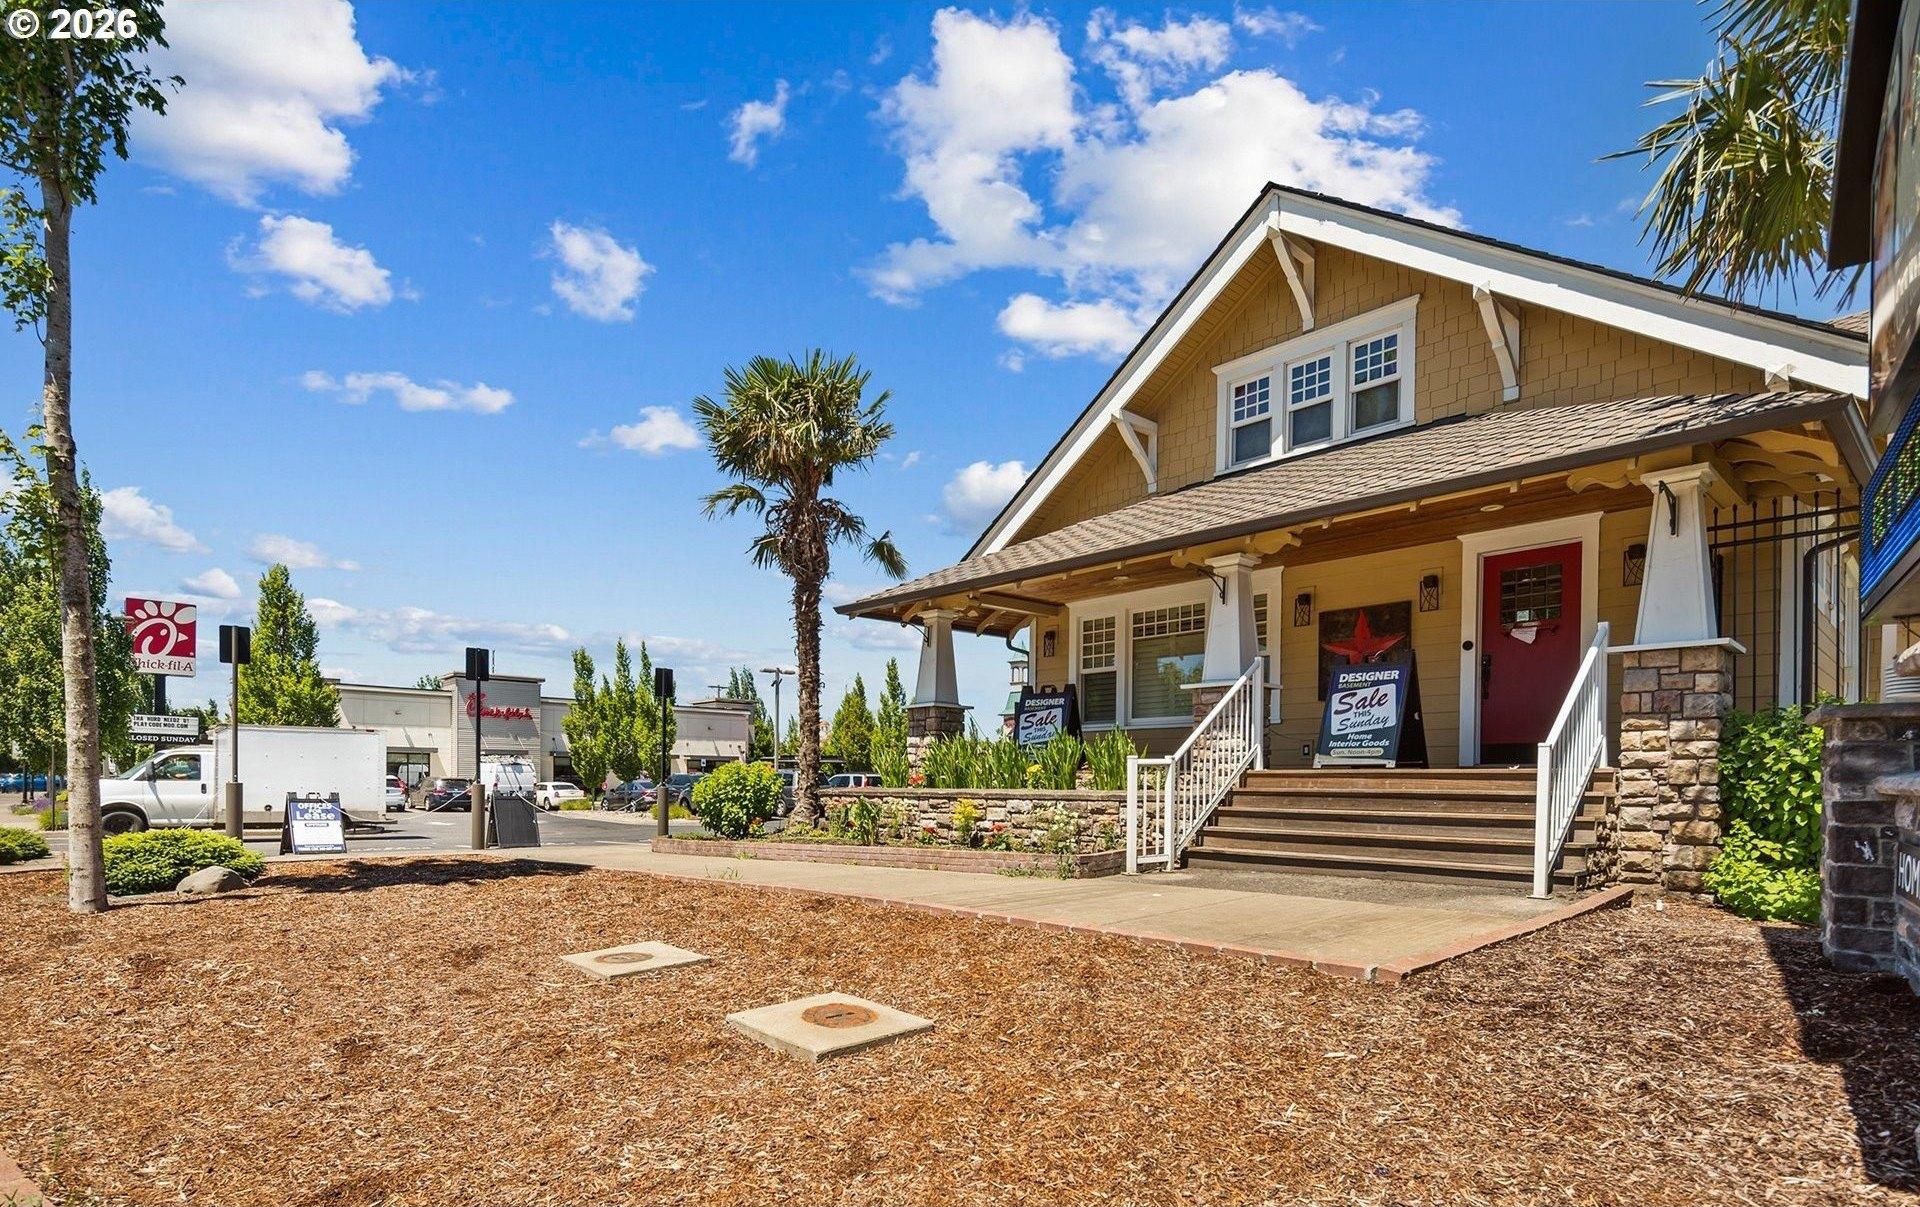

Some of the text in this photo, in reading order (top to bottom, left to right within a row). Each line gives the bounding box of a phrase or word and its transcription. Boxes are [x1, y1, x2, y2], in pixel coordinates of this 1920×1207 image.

[1339, 670, 1400, 682] DESIGNER
[1339, 681, 1372, 689] BASEMENT
[1025, 698, 1065, 706] DESIGNER
[1333, 687, 1389, 715] Sale
[1353, 709, 1372, 718] THIS
[1020, 710, 1057, 730] Sale
[1337, 714, 1389, 732] Sunday
[161, 735, 196, 743] SUNDAY
[1328, 738, 1390, 748] Interior Goods
[295, 810, 336, 820] Lease
[1898, 851, 1920, 899] HOM
